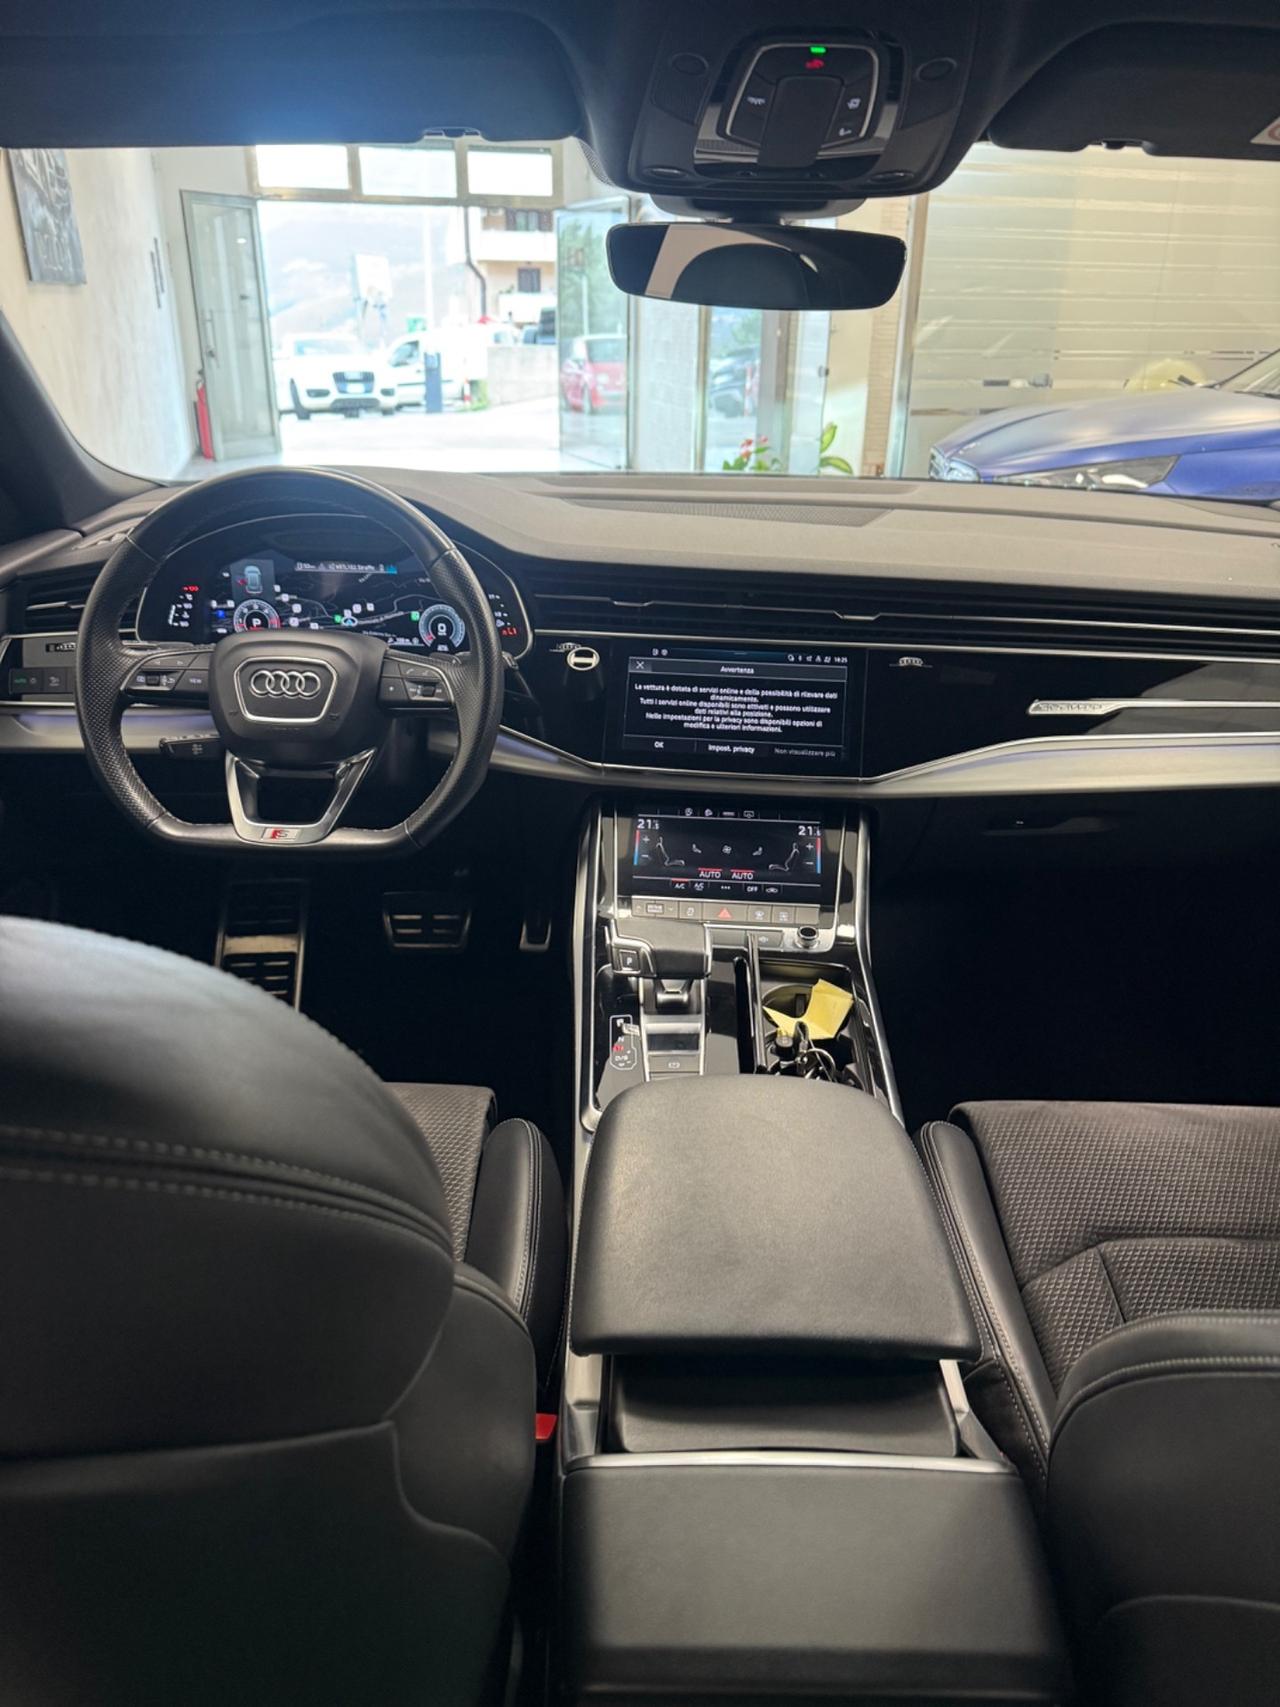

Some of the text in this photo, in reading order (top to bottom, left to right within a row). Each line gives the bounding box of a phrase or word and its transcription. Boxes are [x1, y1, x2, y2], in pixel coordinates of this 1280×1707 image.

[252, 618, 261, 628] P
[720, 665, 754, 675] Avvertenza
[710, 694, 759, 702] dinamicamente.
[662, 713, 702, 721] impostazioni
[708, 744, 755, 754] Impost. privacy
[792, 749, 824, 757] visualizzare
[825, 750, 836, 758] più
[699, 871, 722, 879] AUTO
[731, 872, 754, 880] AUTO
[626, 956, 633, 966] P
